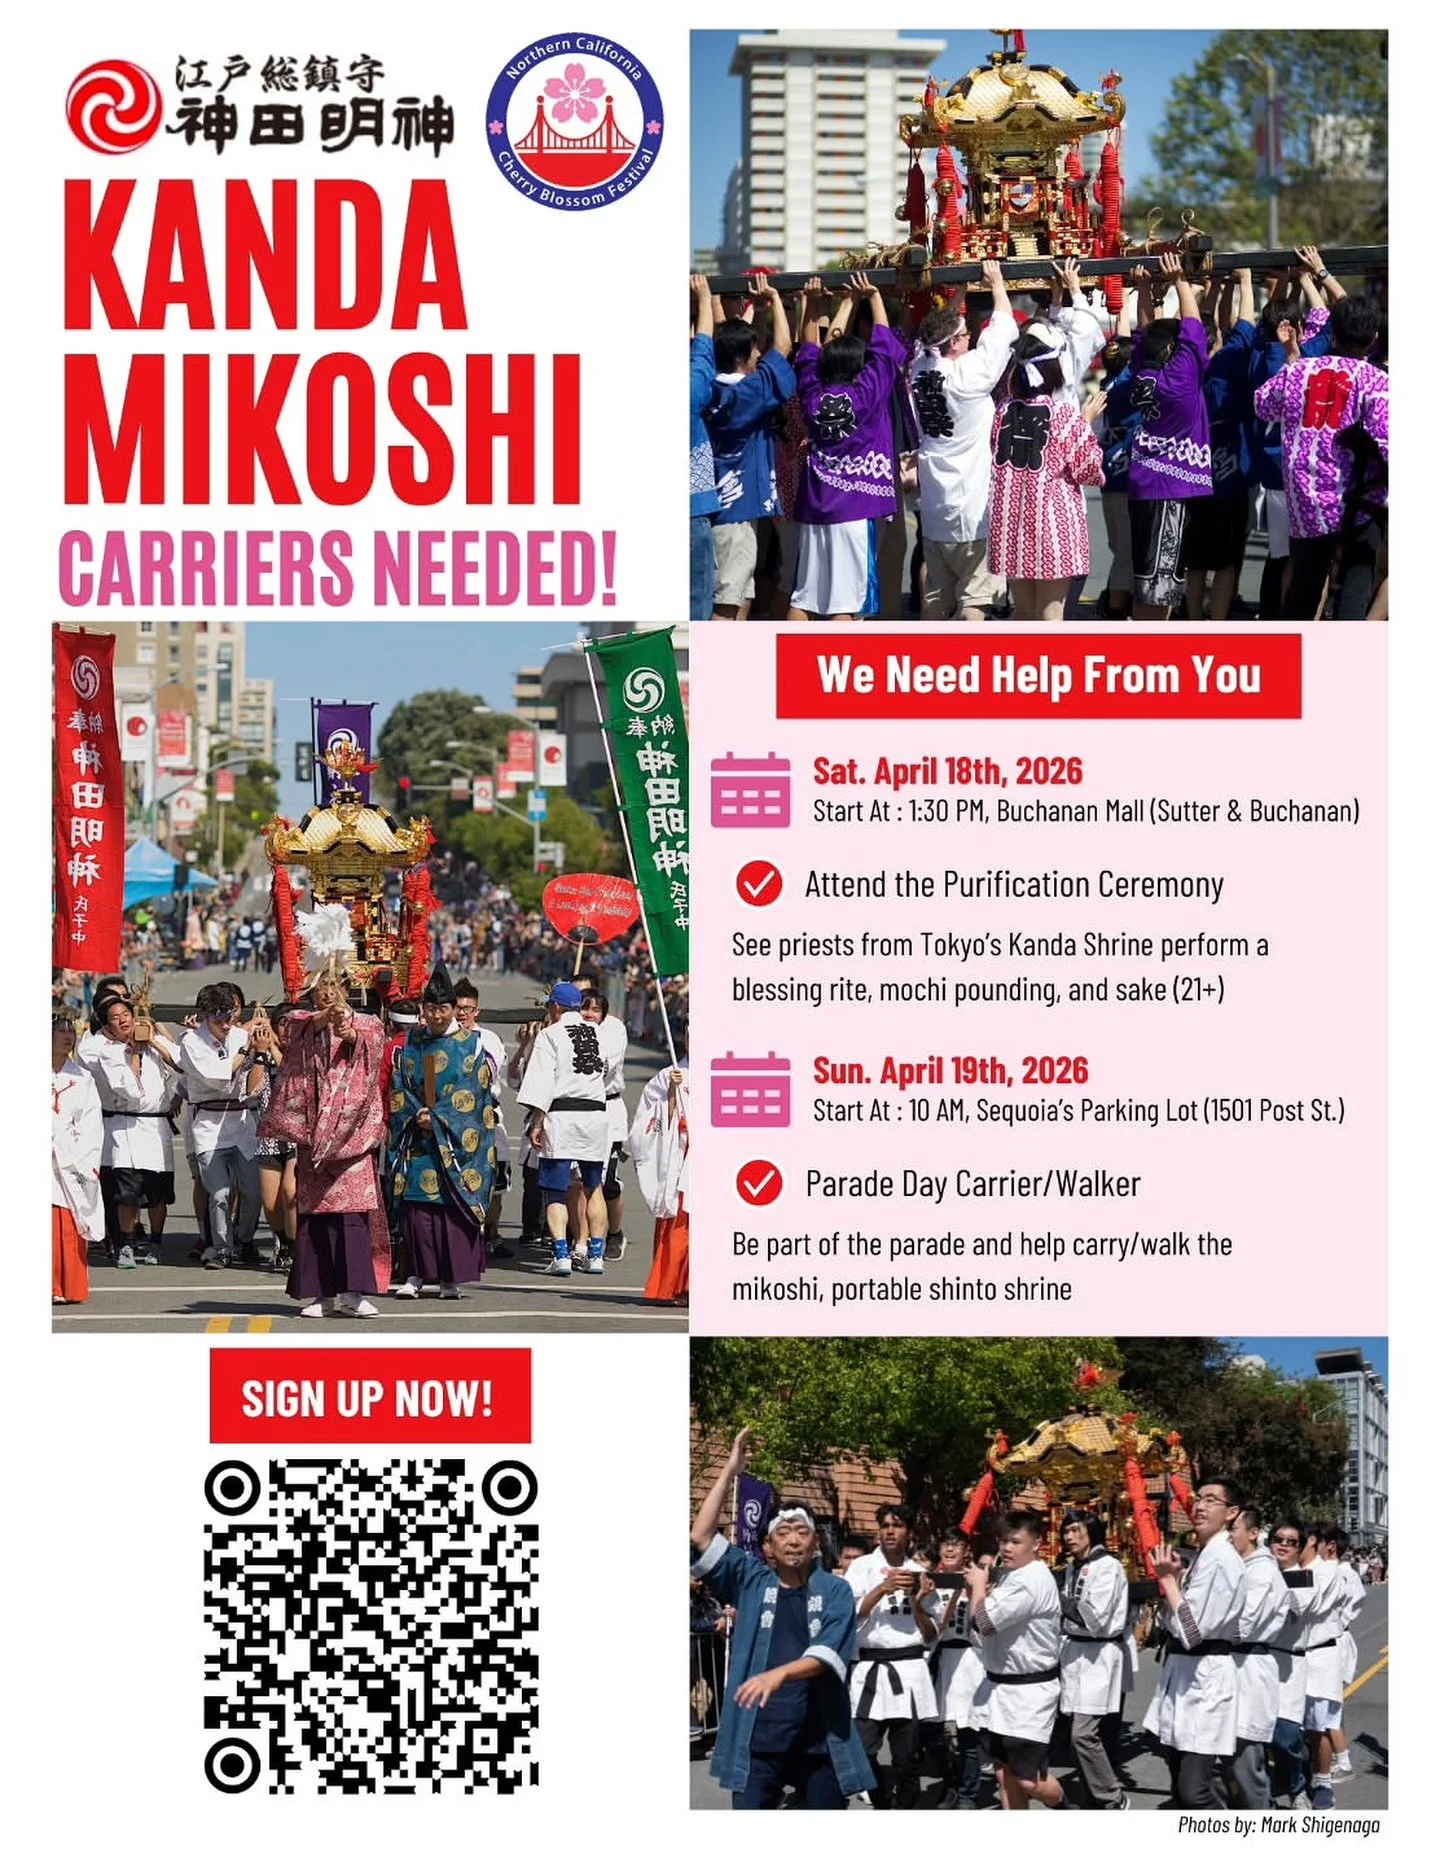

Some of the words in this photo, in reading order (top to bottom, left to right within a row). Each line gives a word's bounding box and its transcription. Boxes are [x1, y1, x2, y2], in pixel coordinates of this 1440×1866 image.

[176, 54, 385, 93] 江戸総鎮守
[506, 39, 571, 80] Northern
[576, 37, 642, 81] California
[165, 95, 455, 158] 神田明神
[498, 151, 538, 195] Cherry
[540, 190, 605, 206] Blossom
[608, 149, 654, 197] Festival
[64, 179, 468, 330] KANDA
[64, 352, 580, 505] MIKOSHI
[59, 529, 354, 607] CARRIERS
[374, 530, 616, 606] NEEDED!
[816, 655, 875, 694] We
[886, 655, 980, 694] Need
[992, 655, 1073, 703] Help
[1084, 655, 1180, 694] From
[1191, 655, 1261, 694] You
[813, 756, 866, 785] Sat.
[873, 755, 938, 792] April
[944, 756, 1008, 789] 18th,
[1015, 756, 1083, 786] 2026
[813, 798, 864, 823] Start
[869, 798, 891, 823] At
[908, 798, 949, 823] 1:30
[956, 798, 990, 825] PM,
[997, 798, 1098, 823] Buchanan
[1106, 798, 1144, 823] Mall
[1149, 797, 1221, 826] (Sutter
[1227, 798, 1243, 823] &
[1250, 797, 1360, 825] Buchanan)
[804, 870, 886, 898] Attend
[894, 870, 935, 898] the
[944, 869, 1090, 898] Purification
[1098, 869, 1225, 905] Ceremony
[732, 931, 772, 957] See
[779, 931, 855, 963] priests
[860, 931, 913, 957] from
[1009, 932, 1077, 957] Kanda
[1083, 931, 1154, 957] Shrine
[1161, 931, 1249, 963] perform
[1256, 937, 1269, 957] a
[732, 976, 822, 1008] blessing
[830, 976, 873, 1004] rite,
[880, 976, 947, 1002] mochi
[954, 976, 1061, 1008] pounding,
[1068, 976, 1108, 1002] and
[1115, 976, 1167, 1002] sake
[1172, 974, 1225, 1005] (21+)
[813, 1055, 872, 1085] Sun.
[879, 1054, 944, 1092] April
[950, 1055, 1014, 1089] 19th,
[1021, 1055, 1089, 1085] 2026
[813, 1098, 864, 1122] Start
[869, 1098, 891, 1122] At
[908, 1098, 930, 1122] 10
[935, 1098, 970, 1124] AM,
[1081, 1098, 1159, 1128] Parking
[1166, 1098, 1199, 1122] Lot
[1203, 1096, 1252, 1125] (1501
[1260, 1098, 1305, 1122] Post
[1310, 1096, 1345, 1125] St.)
[807, 1169, 894, 1198] Parade
[903, 1169, 948, 1205] Day
[956, 1169, 1142, 1198] Carrier/Walker
[733, 1231, 759, 1256] Be
[767, 1233, 812, 1263] part
[818, 1231, 840, 1256] of
[846, 1231, 882, 1256] the
[890, 1231, 965, 1263] parade
[972, 1231, 1012, 1257] and
[1020, 1231, 1066, 1263] help
[1072, 1231, 1191, 1263] carry/walk
[1197, 1231, 1233, 1256] the
[732, 1275, 824, 1304] mikoshi,
[832, 1275, 922, 1307] portable
[929, 1275, 997, 1301] shinto
[1004, 1275, 1072, 1301] shrine
[242, 1379, 325, 1418] SIGN
[337, 1379, 384, 1418] UP
[395, 1379, 492, 1418] NOW!
[1178, 1815, 1231, 1834] Photos
[1234, 1815, 1257, 1839] by:
[1260, 1815, 1298, 1834] Mark
[1301, 1815, 1381, 1839] Shigenaga
